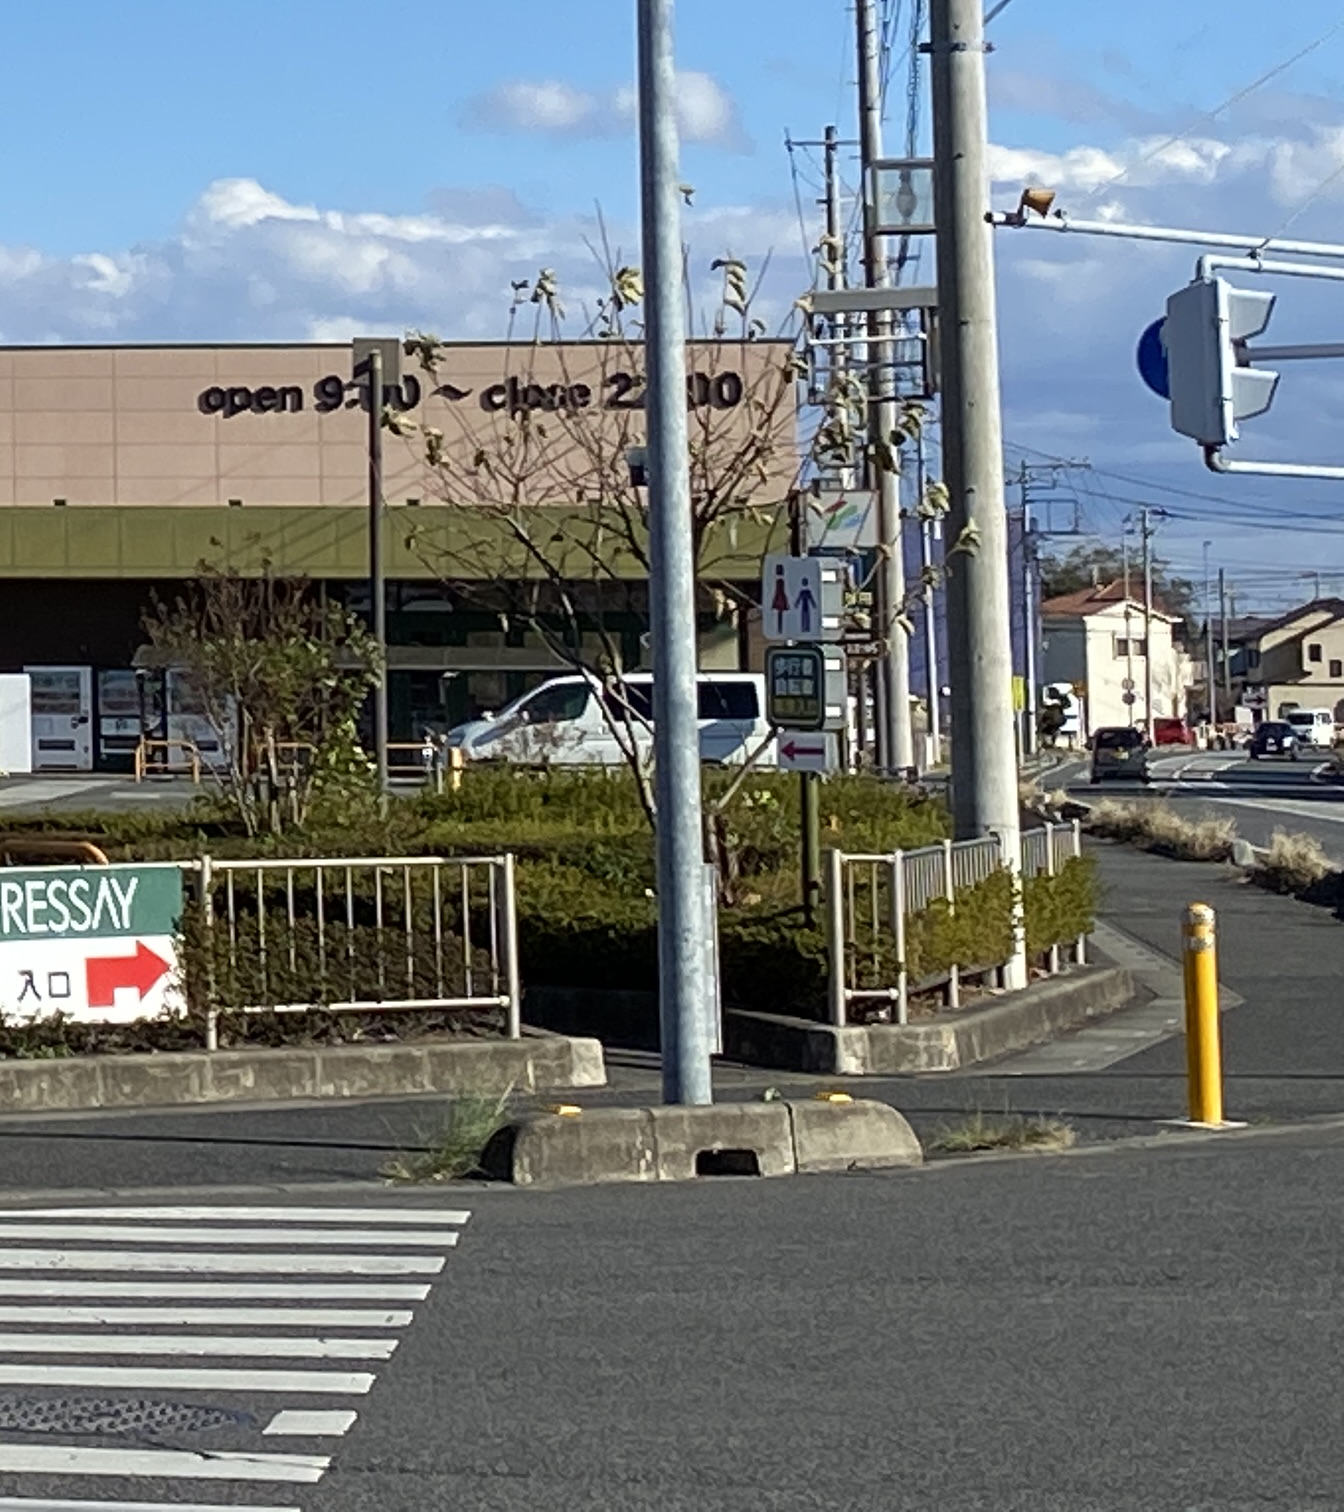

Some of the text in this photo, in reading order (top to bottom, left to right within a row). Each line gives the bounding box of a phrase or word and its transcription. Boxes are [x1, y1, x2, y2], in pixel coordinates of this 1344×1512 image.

[200, 385, 303, 418] open
[480, 375, 591, 412] close
[17, 969, 72, 1002] 入口
